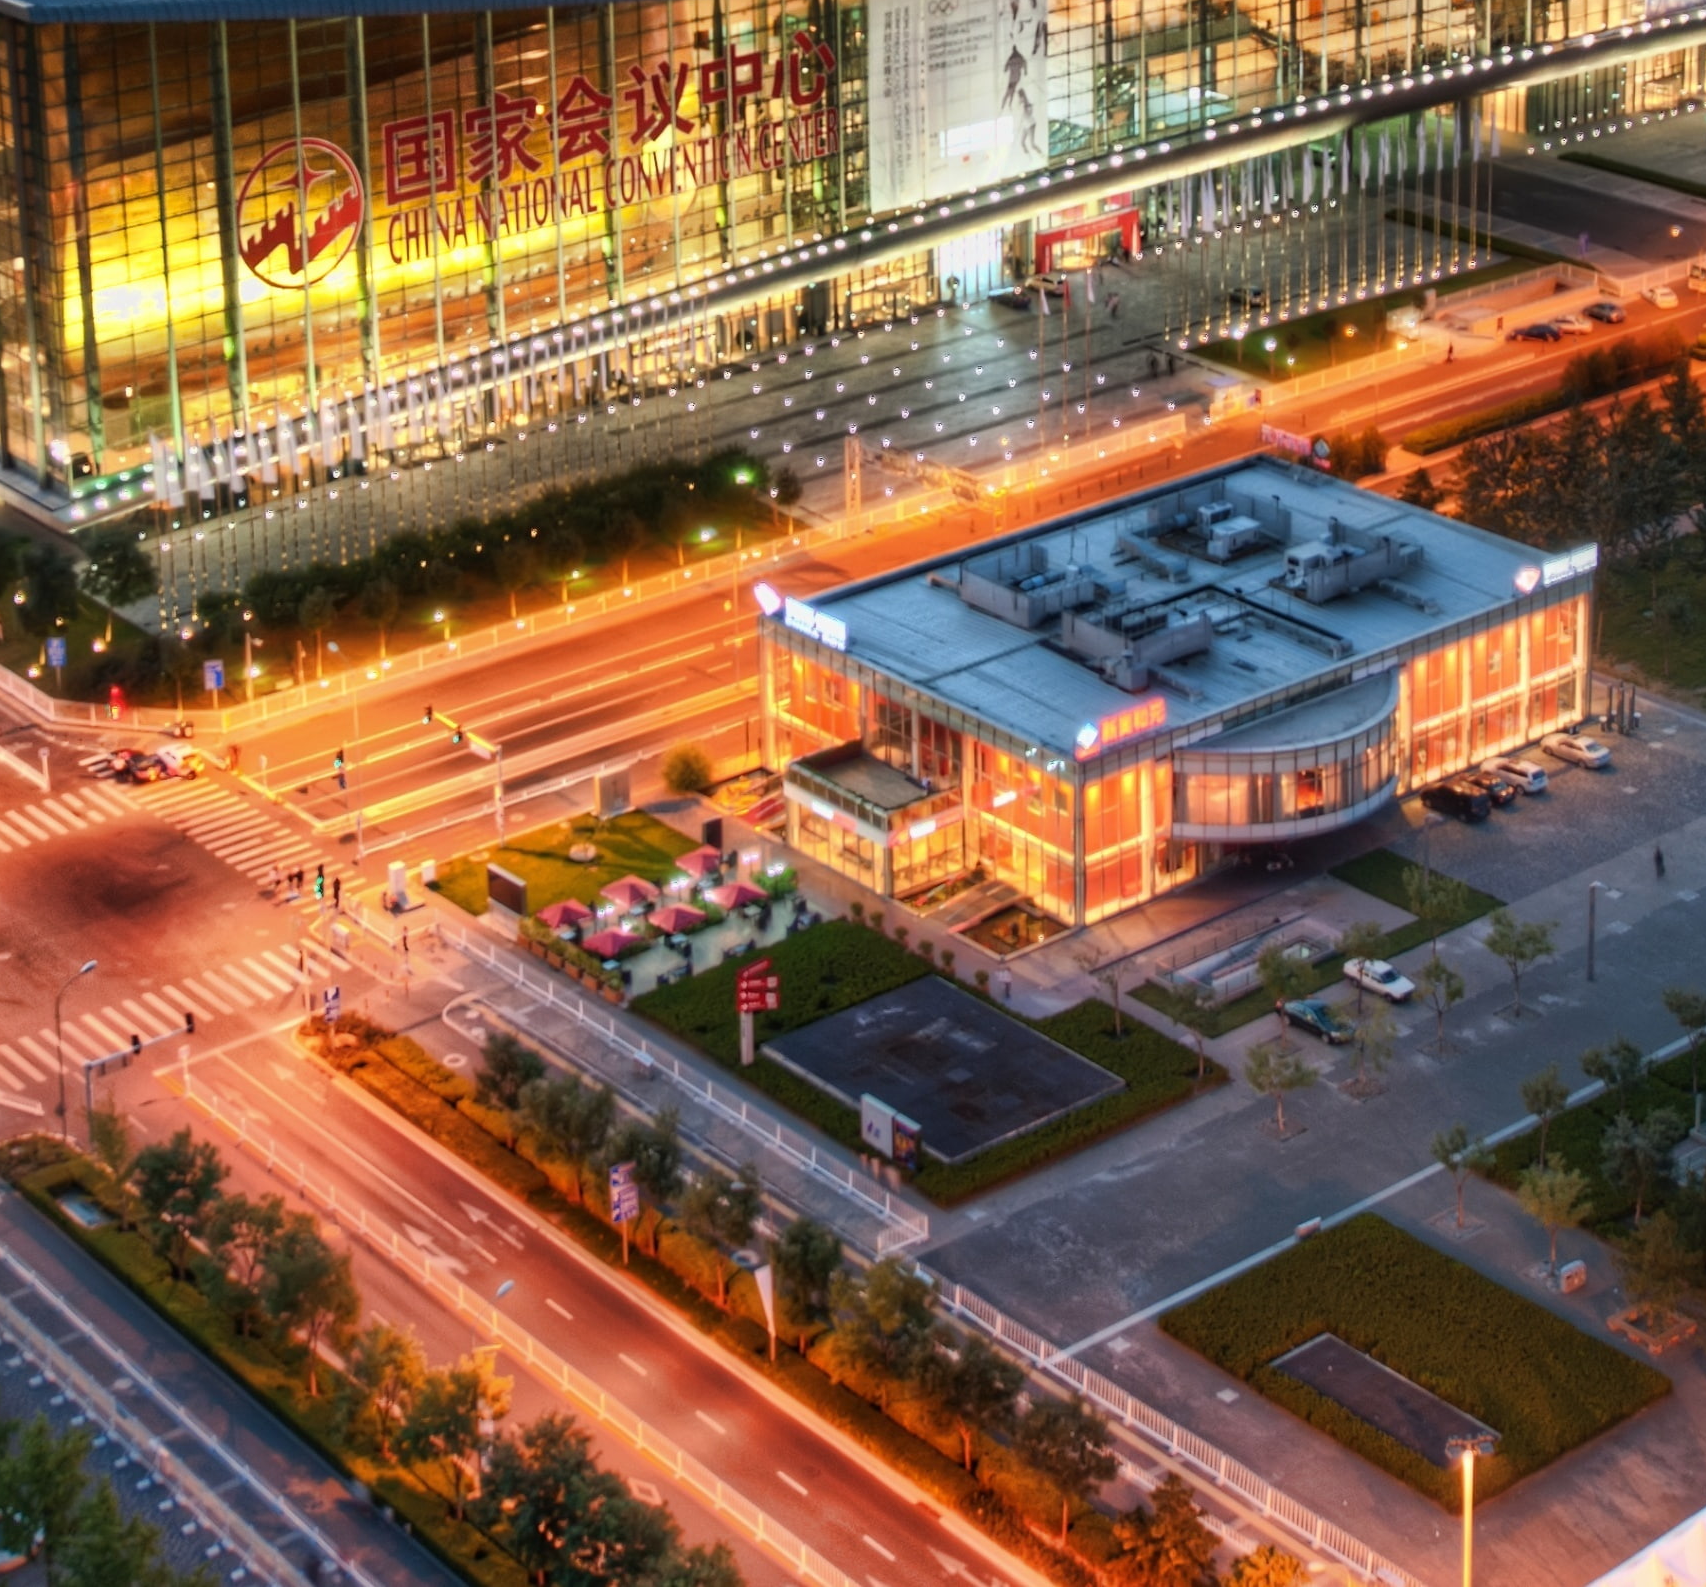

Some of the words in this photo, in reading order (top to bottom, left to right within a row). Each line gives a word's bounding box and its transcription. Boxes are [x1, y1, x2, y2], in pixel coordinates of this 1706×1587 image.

[382, 30, 836, 207] 国家会议中心
[388, 193, 468, 265] CHINA
[475, 166, 597, 242] NATIONAL
[759, 108, 839, 170] CENTER
